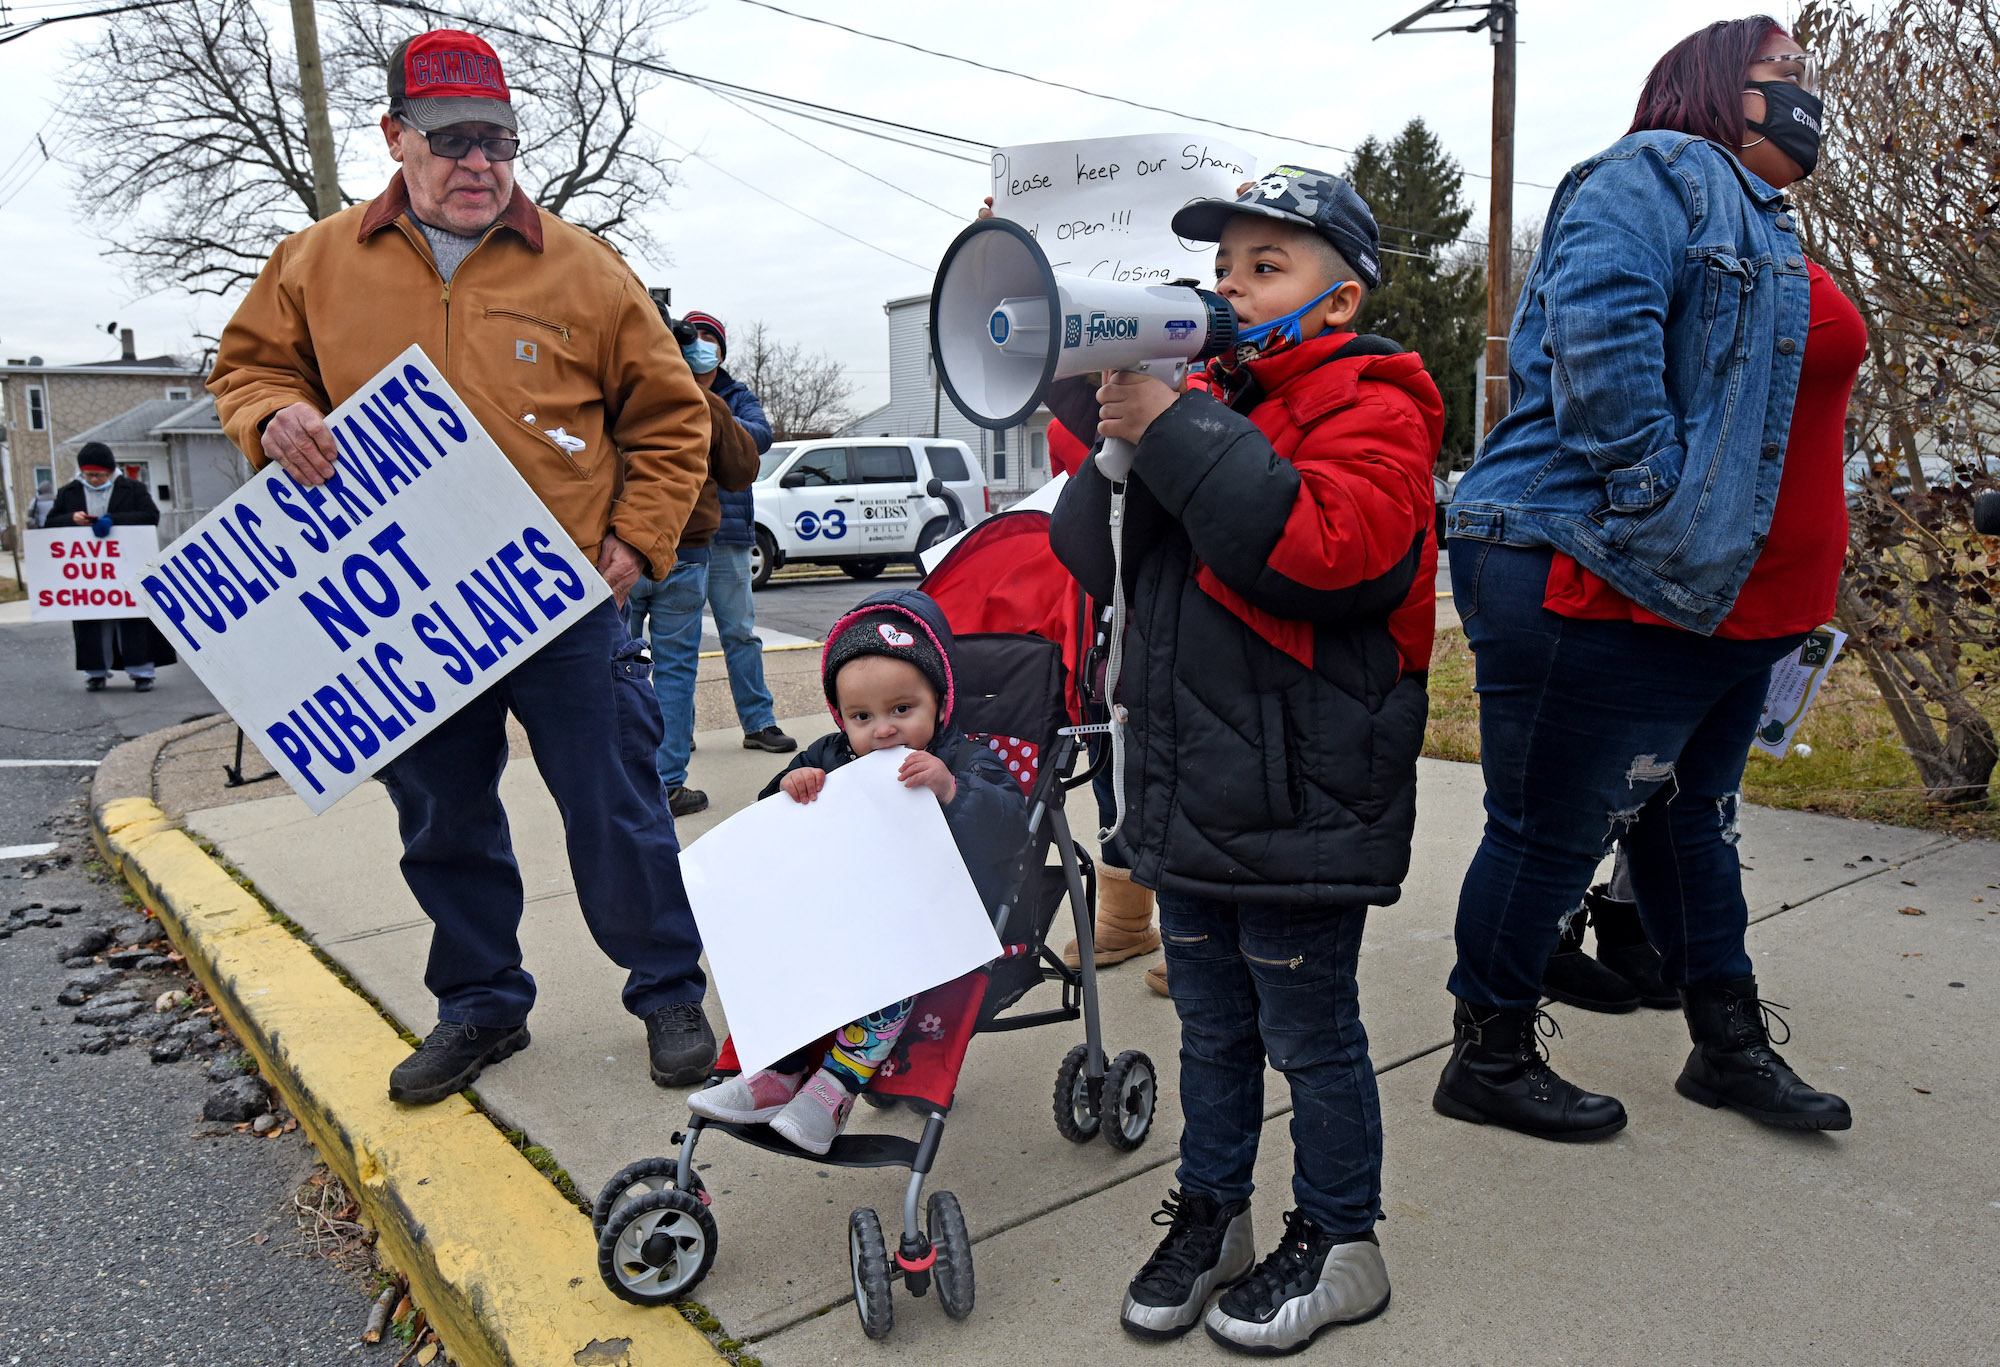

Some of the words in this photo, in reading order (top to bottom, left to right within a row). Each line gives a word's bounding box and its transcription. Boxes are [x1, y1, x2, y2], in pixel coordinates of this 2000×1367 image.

[412, 51, 502, 90] CAMDEN
[992, 153, 1052, 199] Please
[1076, 153, 1120, 185] keep
[1137, 157, 1167, 176] our
[1181, 144, 1244, 175] Sharp
[1084, 311, 1139, 346] FANON
[141, 504, 296, 651] PUBLIC
[267, 365, 467, 554] SERVANTS
[874, 506, 907, 519] CBSN
[822, 509, 847, 539] 3
[865, 524, 908, 533] PHILLY
[50, 540, 121, 558] SAVE
[63, 562, 116, 580] OUR
[39, 589, 137, 607] SCHOOL
[300, 522, 431, 652] NOT
[267, 643, 436, 794] PUBLIC
[412, 528, 584, 684] SLAVES
[809, 1083, 835, 1106] Minnie
